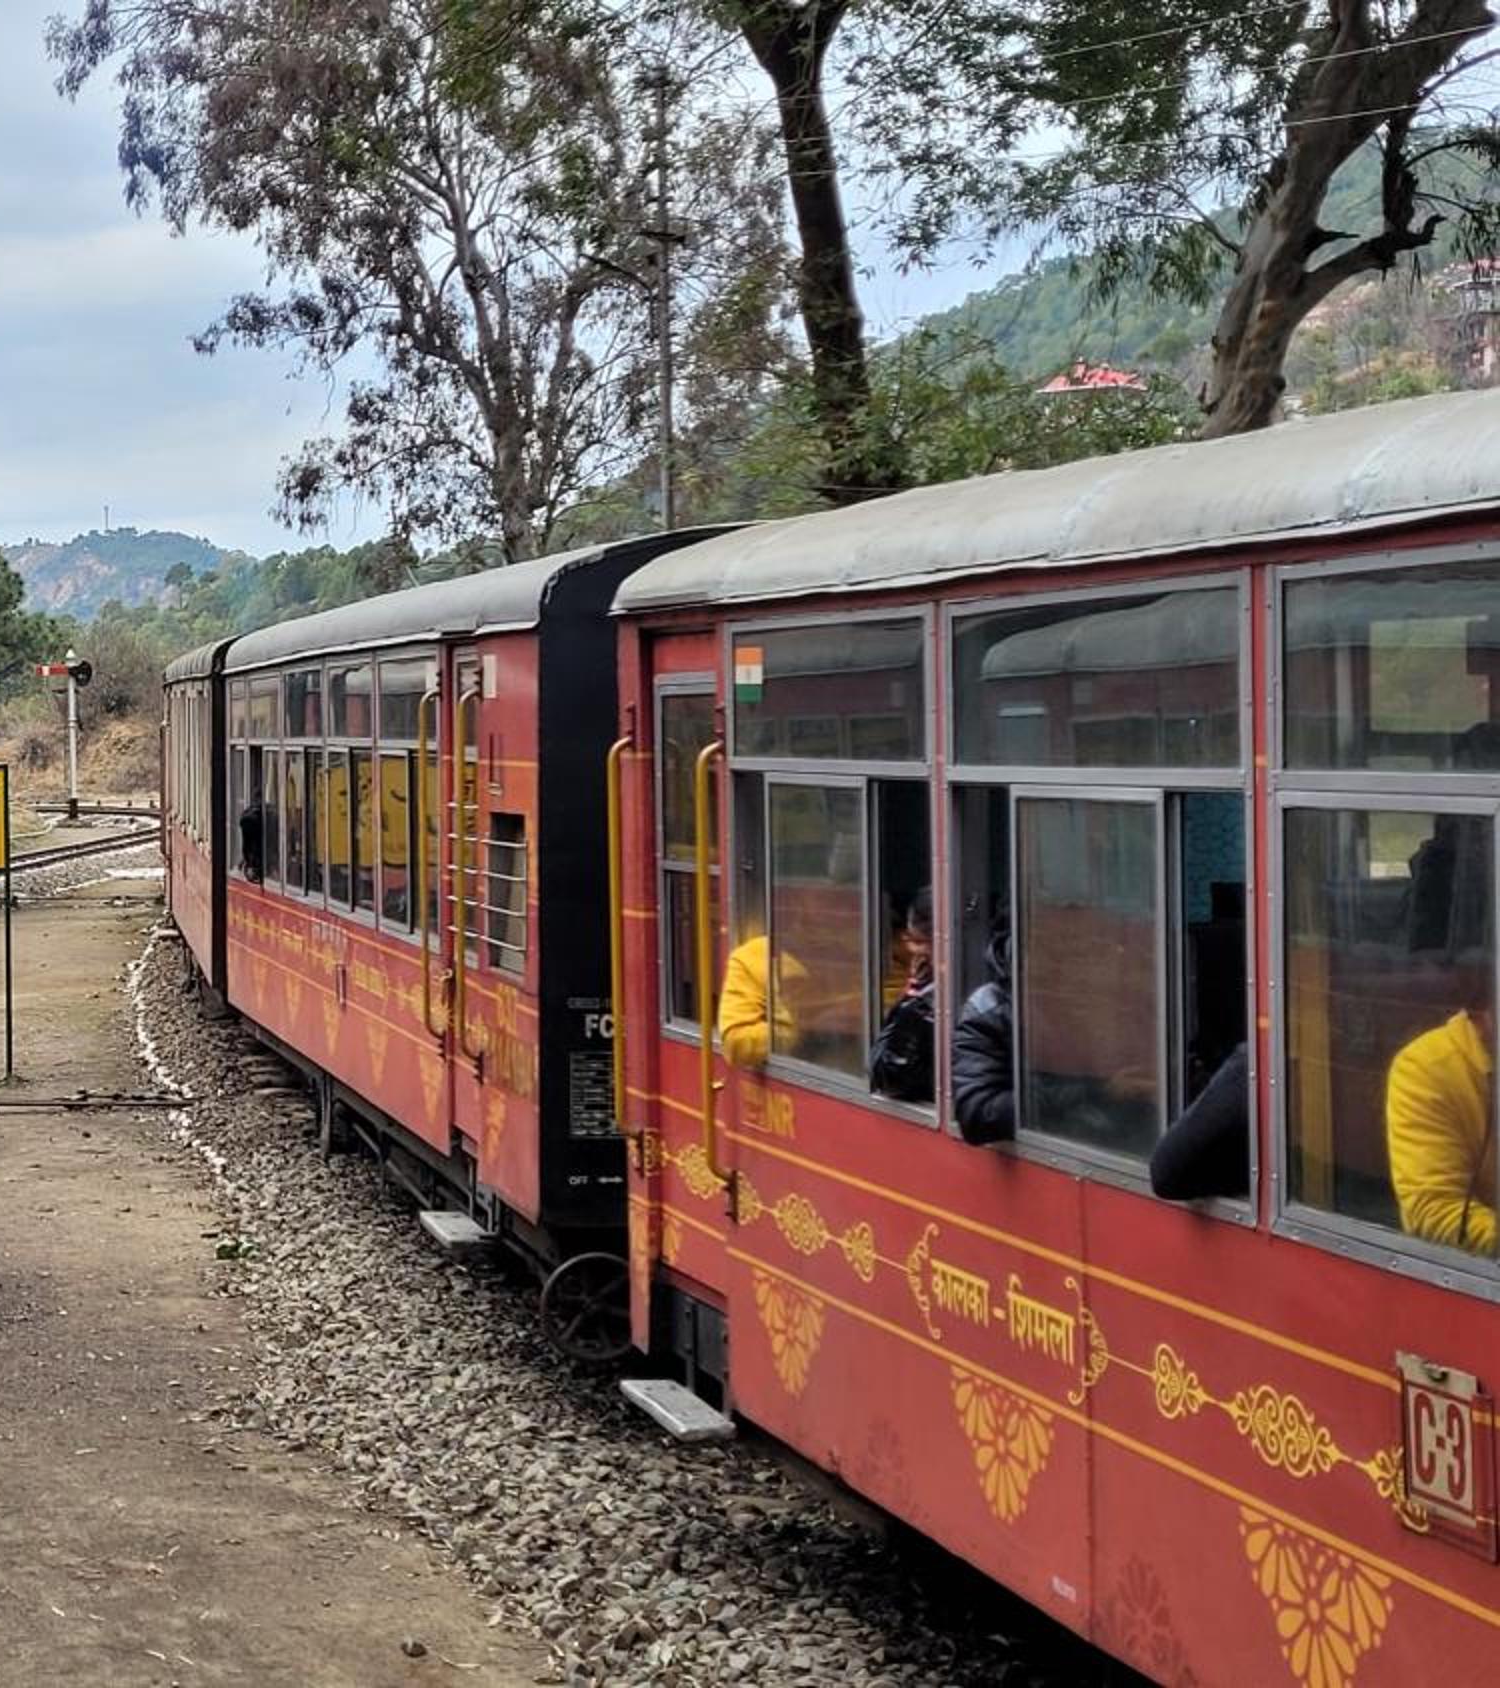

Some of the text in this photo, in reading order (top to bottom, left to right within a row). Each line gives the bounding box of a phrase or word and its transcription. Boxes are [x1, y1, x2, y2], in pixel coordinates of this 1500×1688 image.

[930, 1258, 990, 1328] कालका
[1006, 1273, 1075, 1365] शिमला
[1413, 1390, 1467, 1502] C-3
